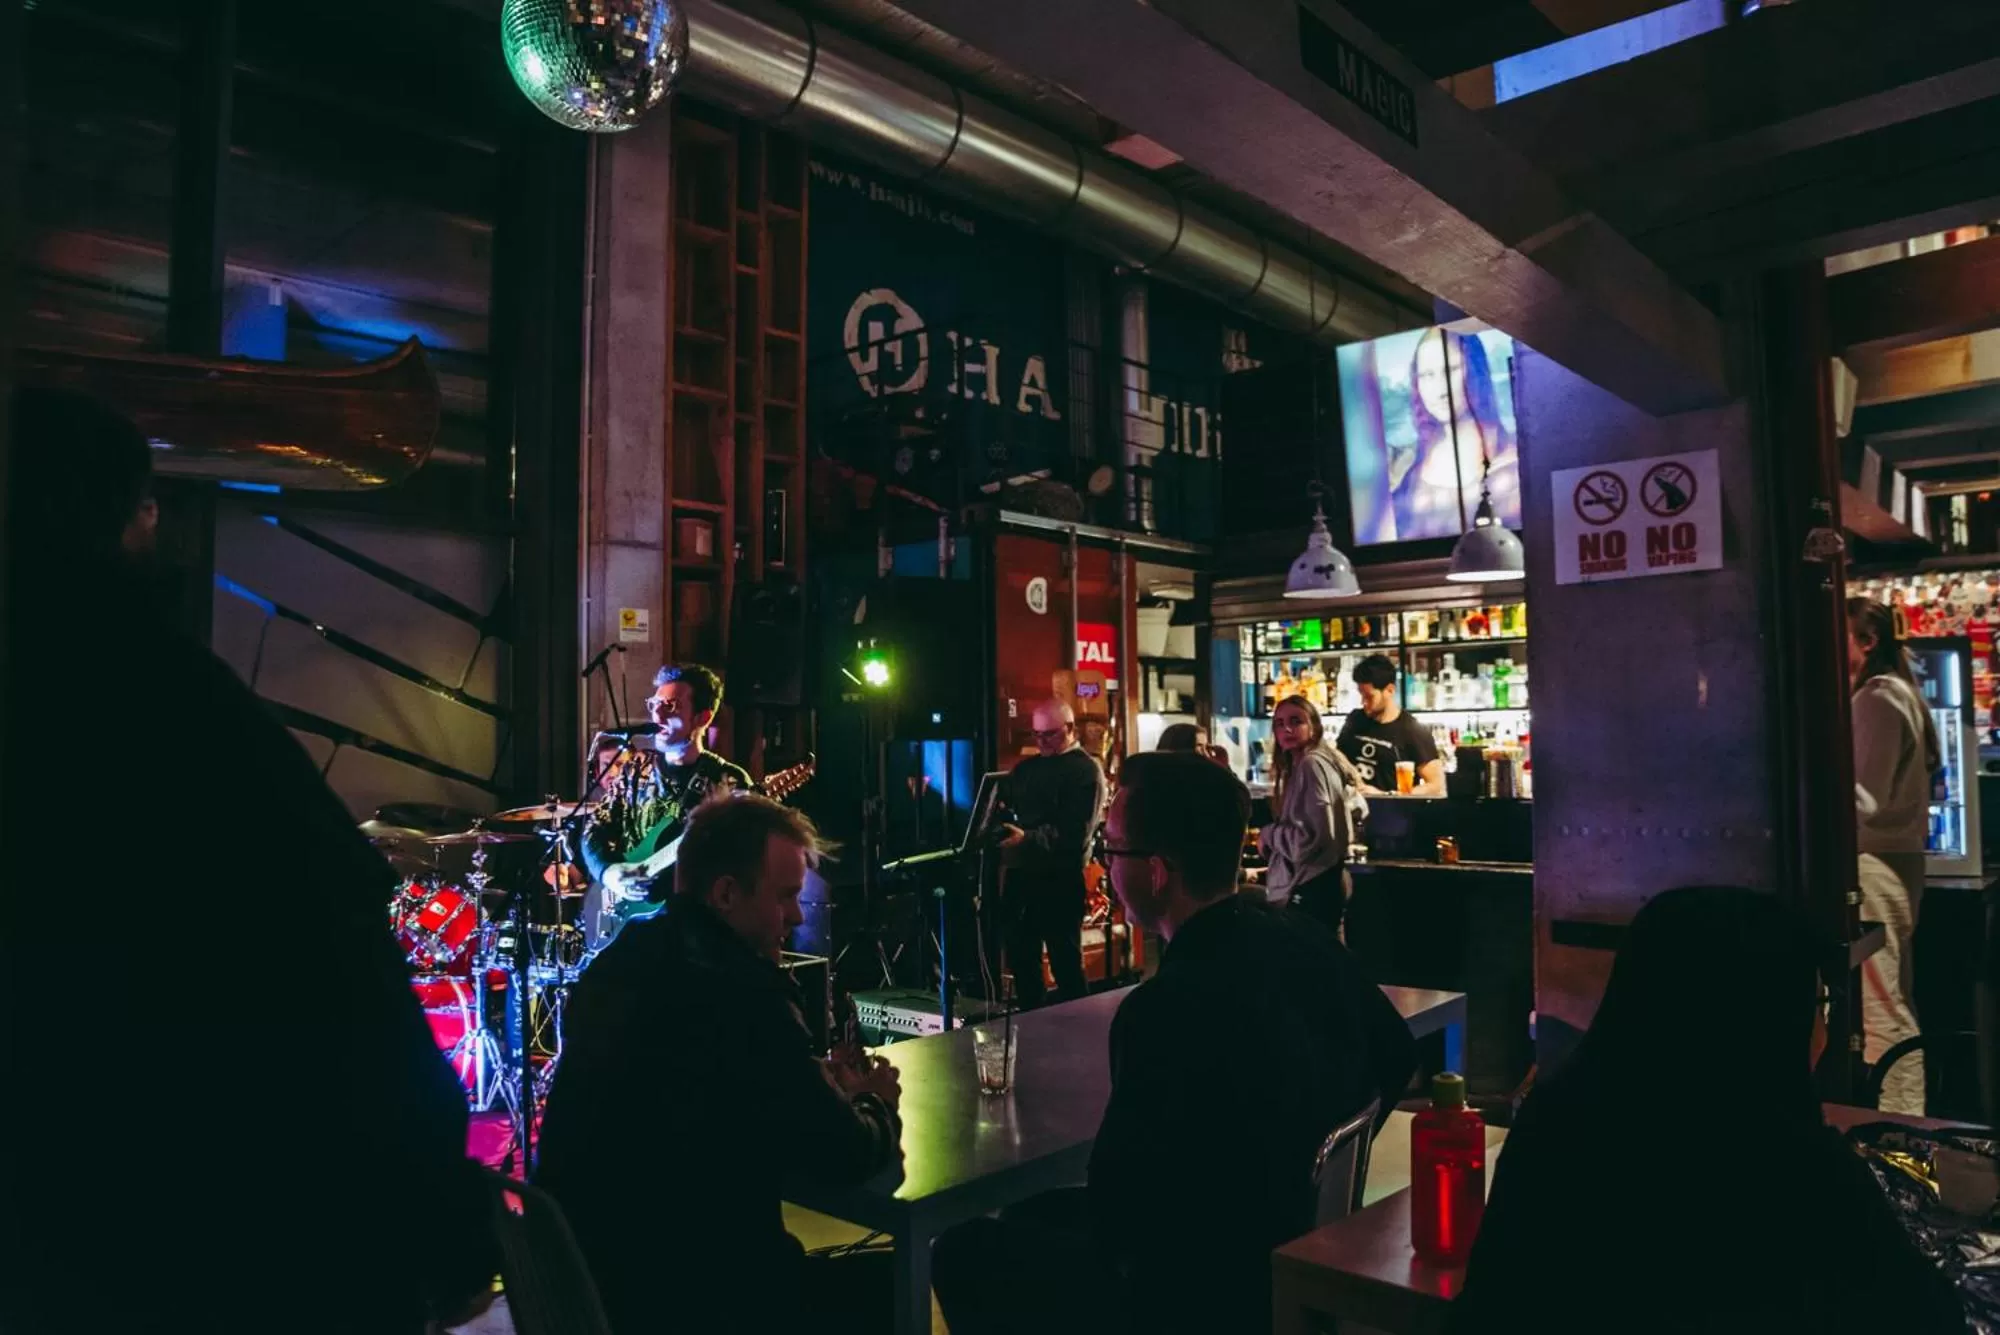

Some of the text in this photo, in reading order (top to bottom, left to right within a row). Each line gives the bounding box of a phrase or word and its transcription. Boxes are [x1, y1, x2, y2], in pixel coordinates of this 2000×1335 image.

[1337, 42, 1411, 134] MAGIC
[1579, 530, 1627, 562] NO
[1647, 522, 1696, 555] NO
